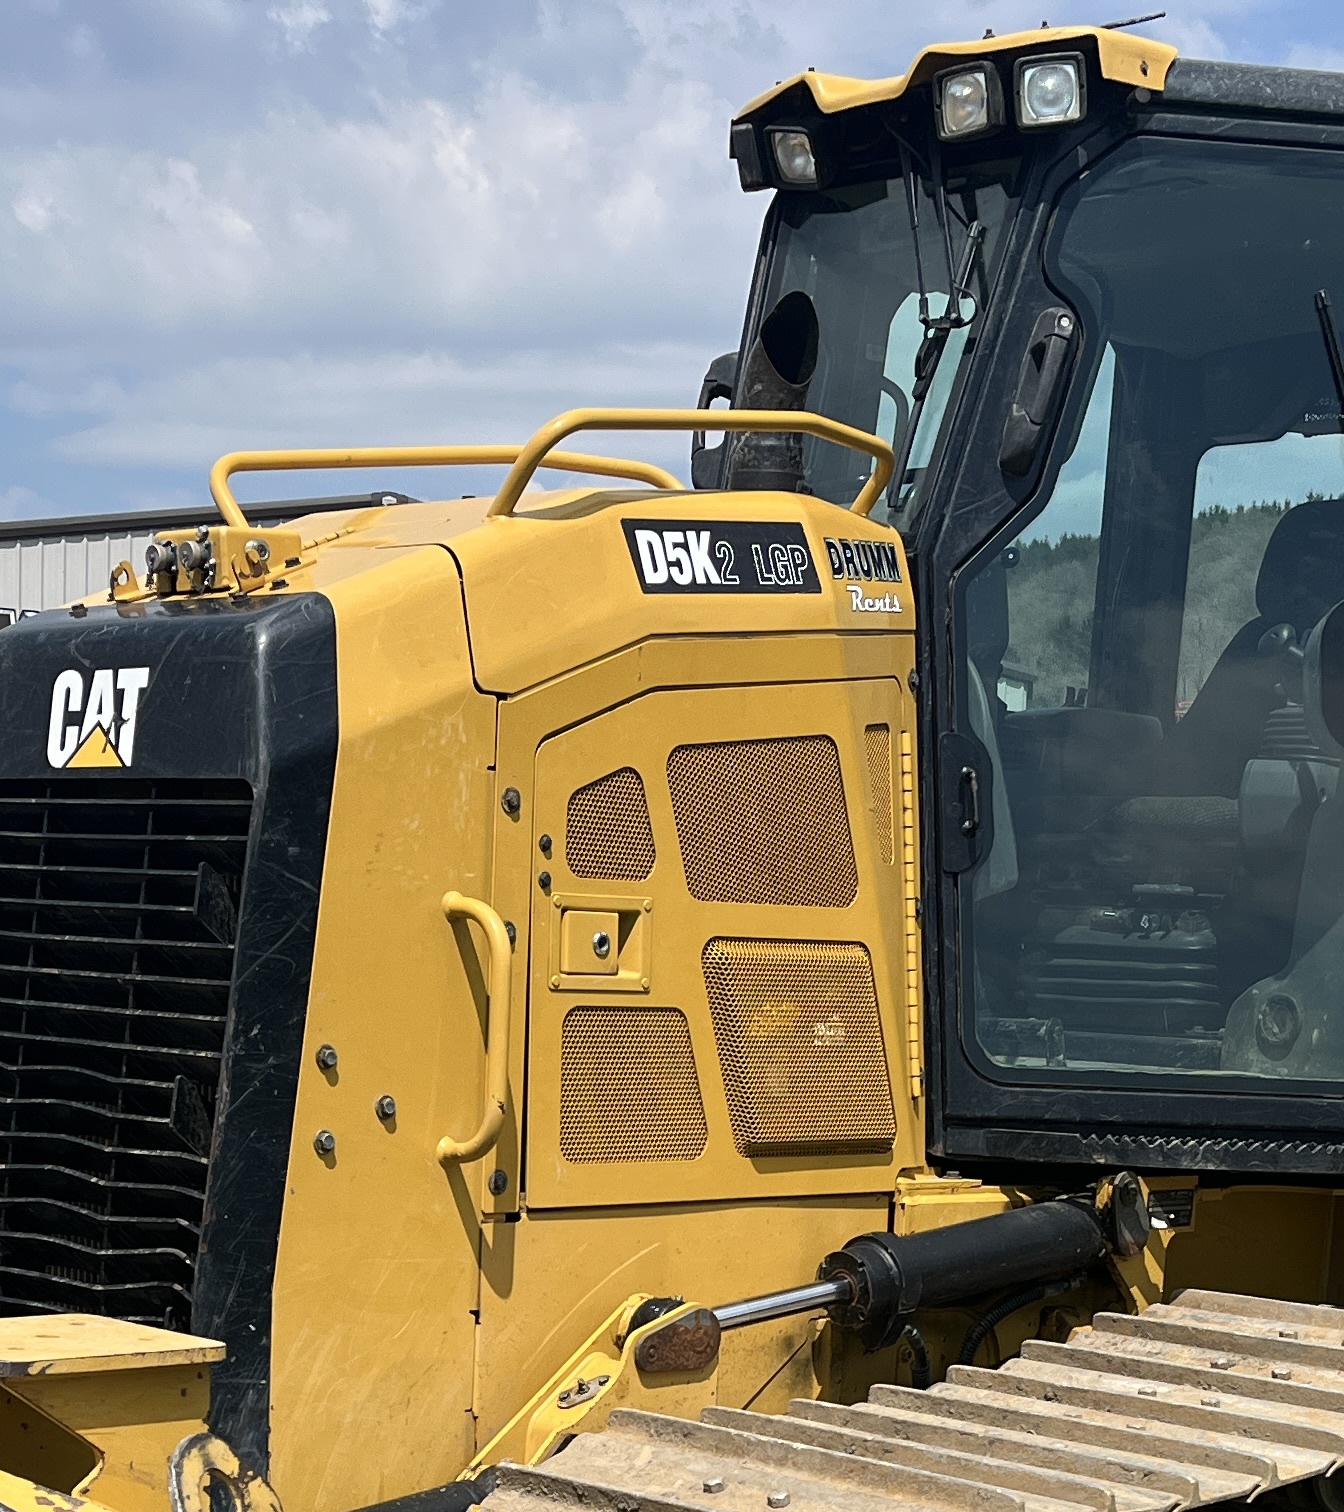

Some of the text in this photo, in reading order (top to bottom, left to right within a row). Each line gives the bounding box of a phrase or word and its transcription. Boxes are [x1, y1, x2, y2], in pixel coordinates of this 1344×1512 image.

[634, 529, 809, 586] D5K2 LGP
[824, 537, 903, 583] DRUMM
[846, 585, 903, 613] Rents
[46, 667, 150, 768] CAT
